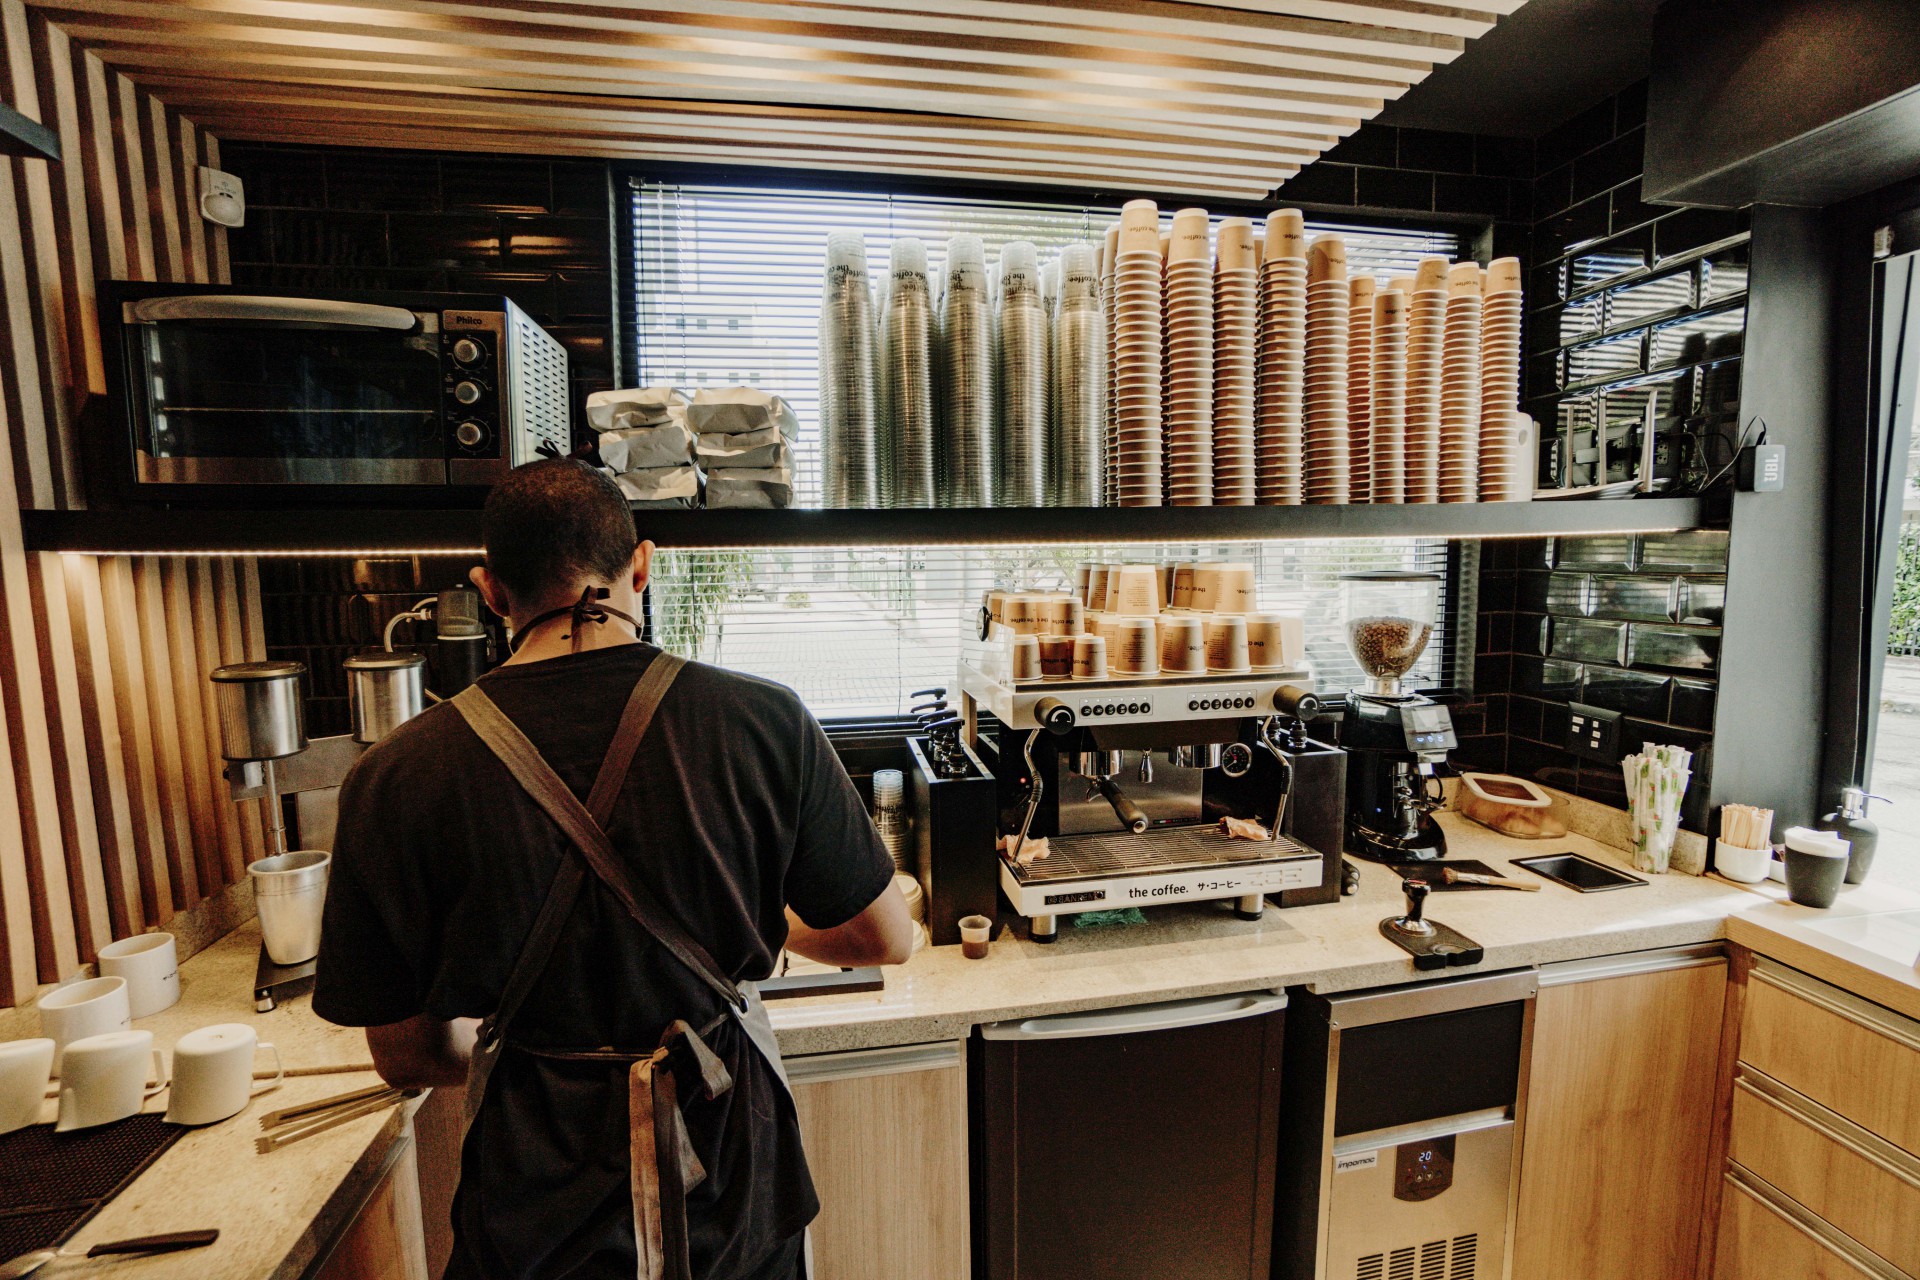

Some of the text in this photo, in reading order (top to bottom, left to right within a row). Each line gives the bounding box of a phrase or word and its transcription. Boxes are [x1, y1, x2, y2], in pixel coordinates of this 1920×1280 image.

[1067, 275, 1092, 284] coffee.
[456, 316, 483, 325] Philco
[1764, 453, 1779, 482] JBL
[1128, 884, 1189, 899] the coffee.
[1197, 880, 1242, 891] サ・コーヒー
[1418, 1150, 1432, 1162] 20
[1337, 1156, 1376, 1170] impomac
